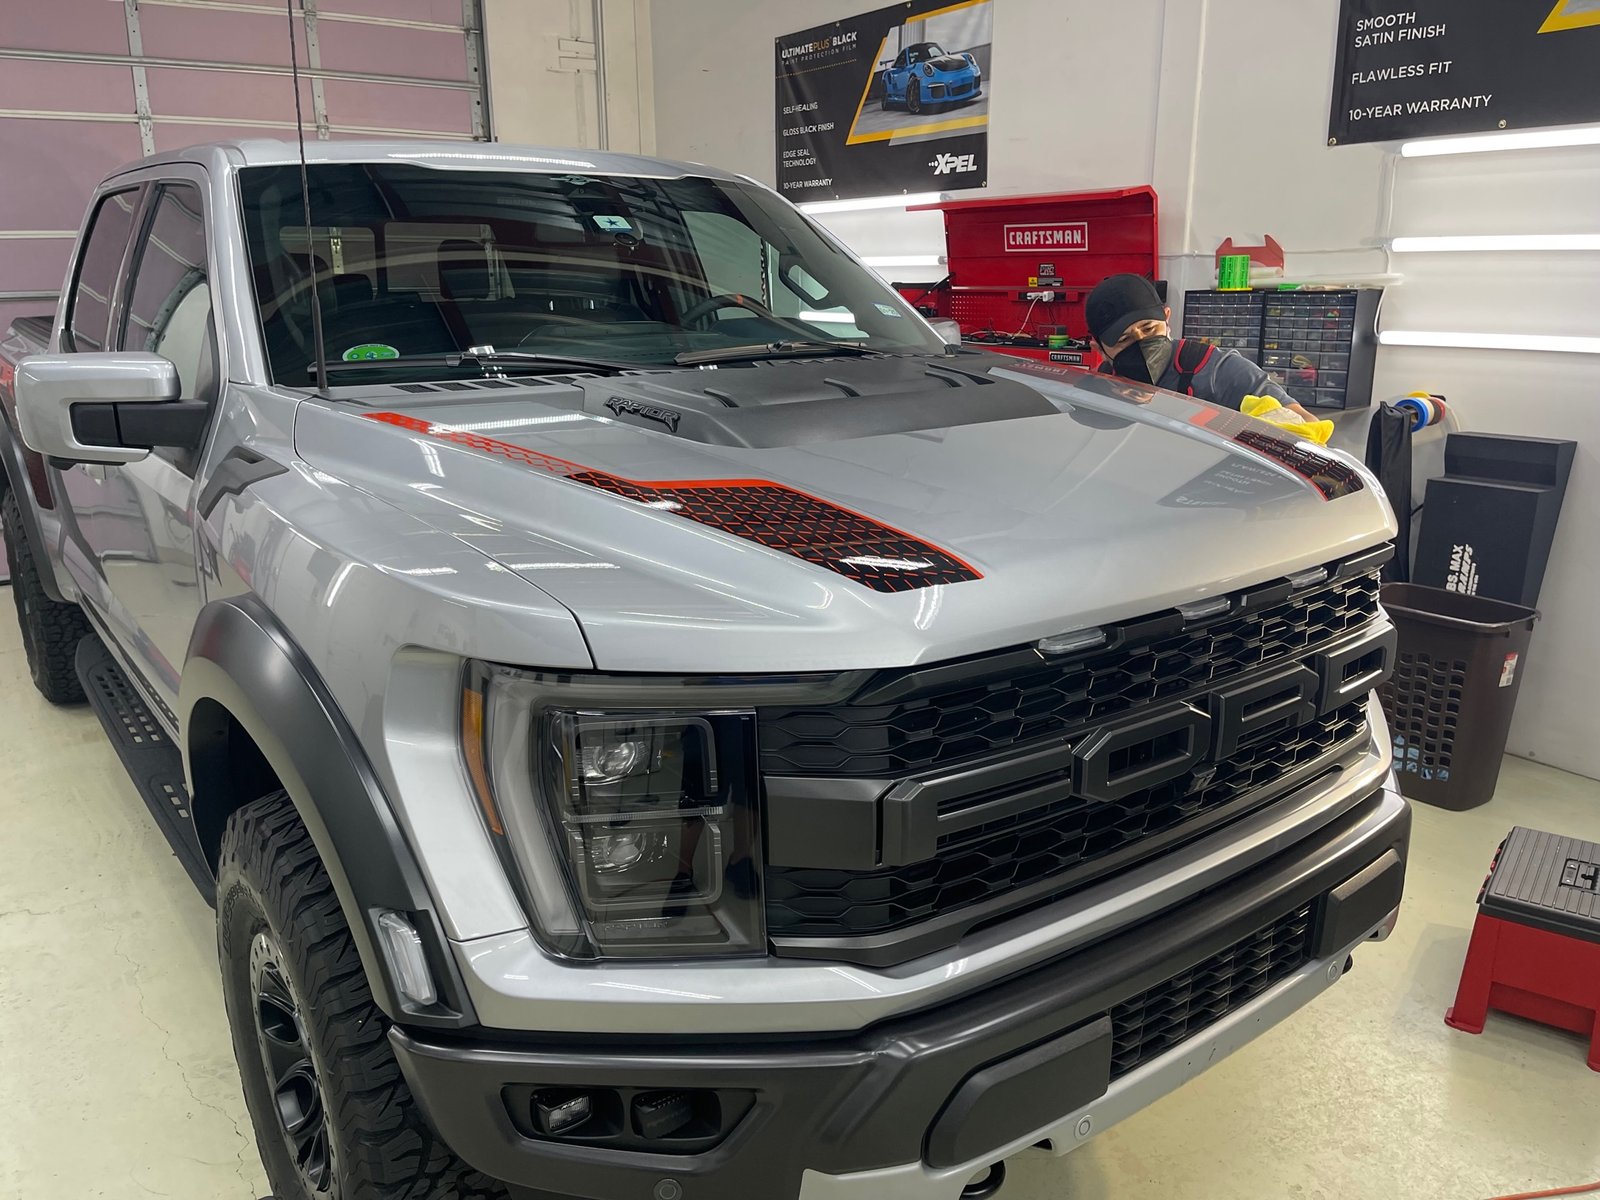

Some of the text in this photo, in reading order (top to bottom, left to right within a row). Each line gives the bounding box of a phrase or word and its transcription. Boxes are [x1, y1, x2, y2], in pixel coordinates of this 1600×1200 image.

[1356, 11, 1416, 32] SMOOTH
[832, 32, 857, 46] BLACK
[1354, 23, 1446, 48] SATIN FINISH
[801, 48, 839, 61] PROTECTION
[842, 43, 857, 52] FILM
[1351, 60, 1452, 85] FLAWLESS FIT
[783, 102, 818, 114] SELF-HEALING
[1348, 94, 1492, 121] 10-YEAR WARRANTY
[783, 128, 799, 136] GLOSS
[817, 121, 835, 132] FINISH
[783, 148, 810, 159] EDGE SEAL
[783, 157, 817, 168] TECHNOLOGY
[933, 152, 978, 176] XPEL
[783, 178, 833, 190] 10-YEAR WARRANTY
[1009, 229, 1083, 246] CRAFTSMAN
[1050, 353, 1081, 363] CRAFTSMAN
[604, 396, 681, 433] RAPTOR
[1450, 544, 1463, 571] MAX
[884, 621, 1398, 867] FORD
